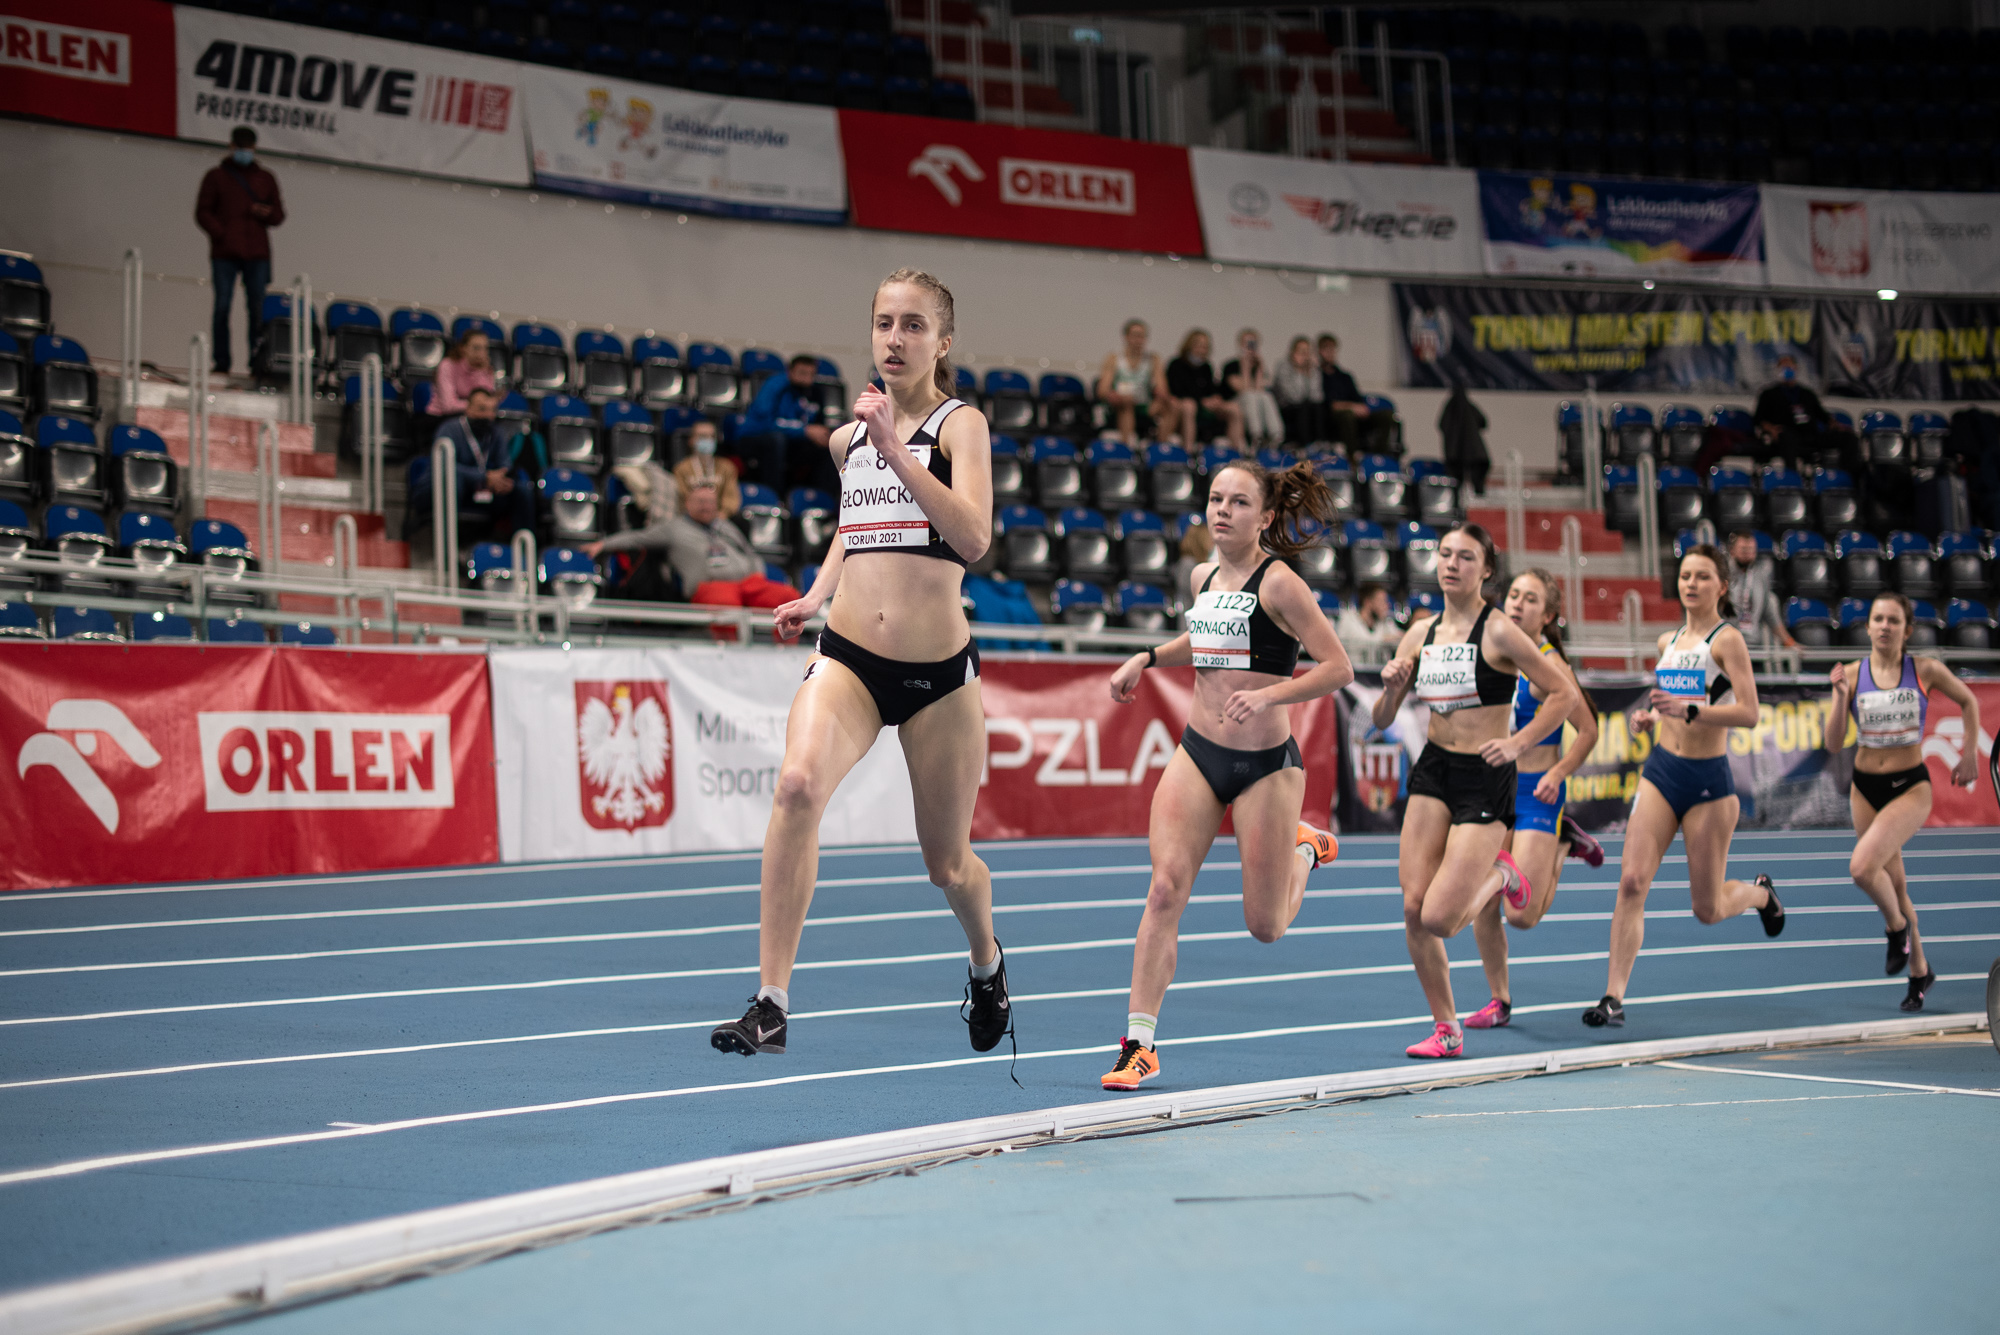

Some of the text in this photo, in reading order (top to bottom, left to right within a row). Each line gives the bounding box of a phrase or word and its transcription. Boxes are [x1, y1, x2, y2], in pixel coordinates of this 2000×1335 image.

[0, 24, 118, 75] RLEN
[195, 39, 417, 117] 4MOVE
[1009, 167, 1126, 204] ORLEN
[842, 486, 914, 509] GŁOWACK
[848, 531, 902, 545] TORUŃ 2021
[1213, 594, 1256, 614] 1122
[1190, 620, 1248, 637] ORNACKA
[1210, 657, 1229, 666] 2021
[218, 726, 434, 795] ORLEN
[979, 718, 1177, 786] PZLA
[698, 762, 781, 803] Sport
